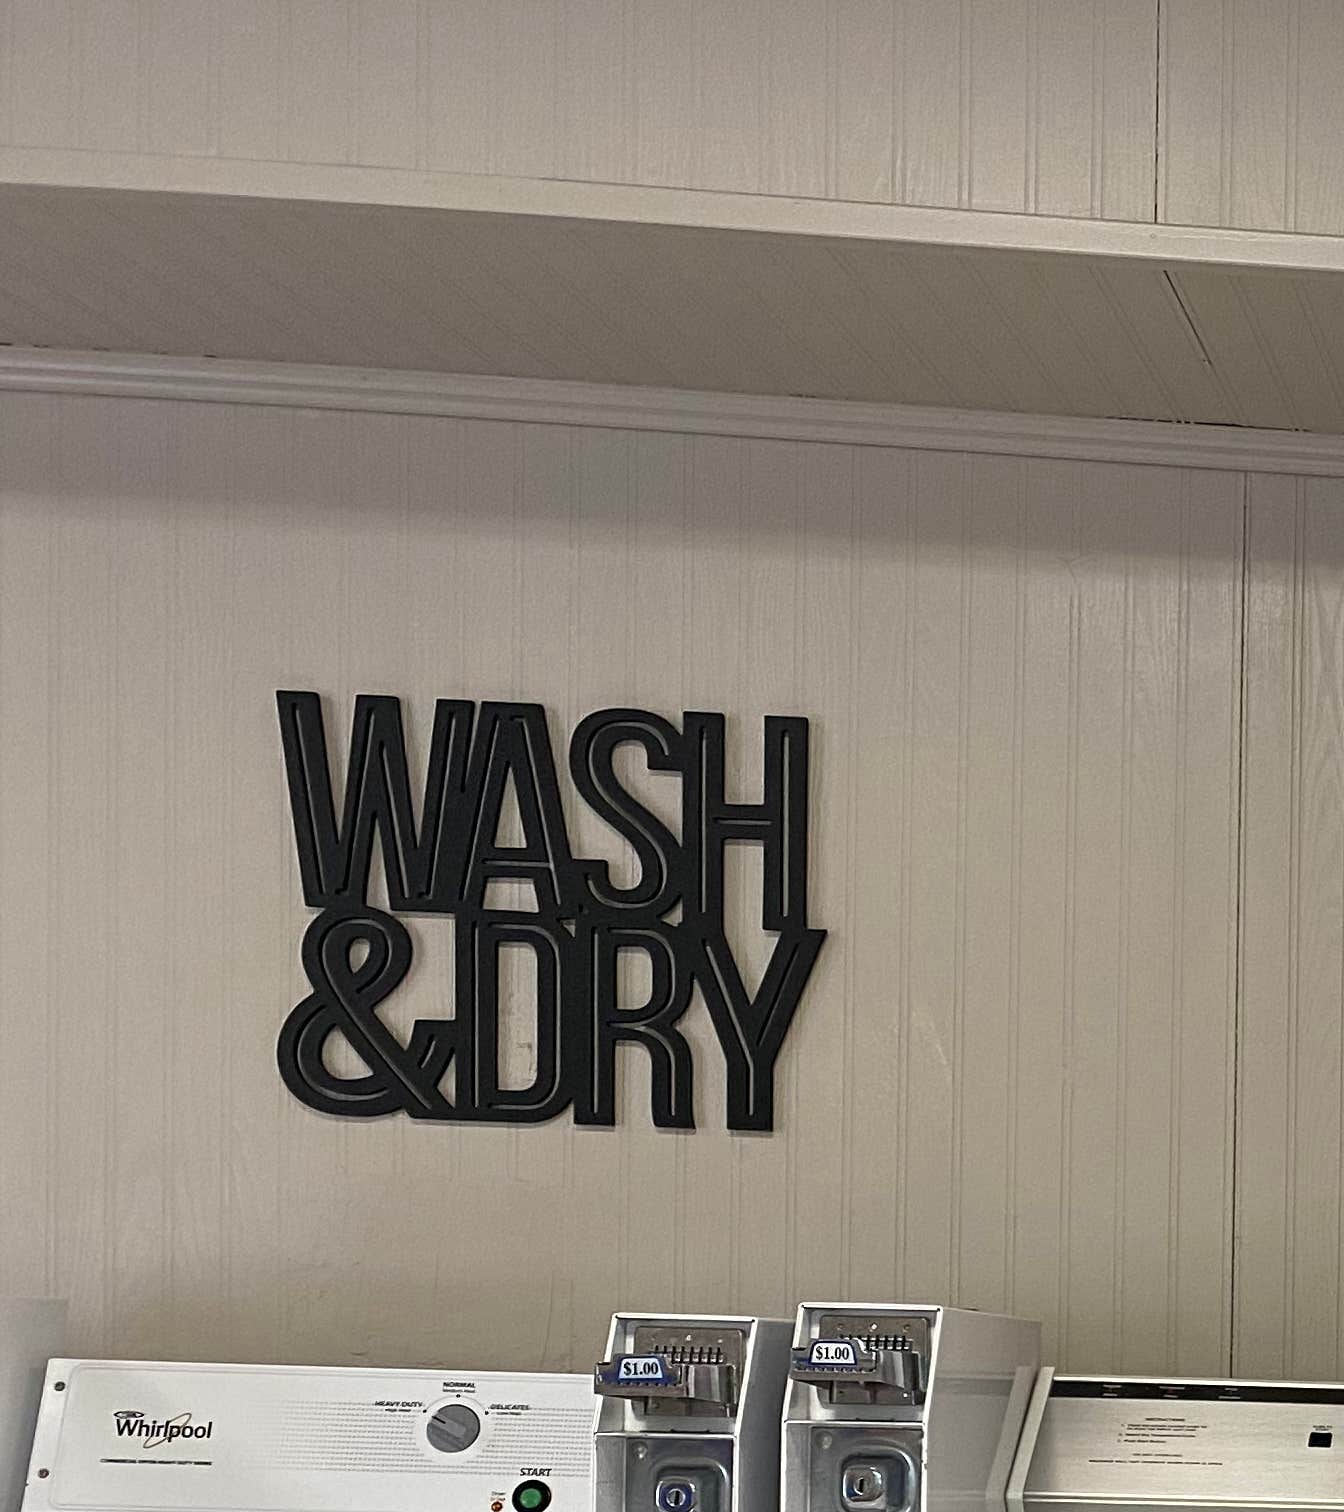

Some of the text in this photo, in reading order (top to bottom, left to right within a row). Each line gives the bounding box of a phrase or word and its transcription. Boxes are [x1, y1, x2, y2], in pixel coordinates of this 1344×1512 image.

[276, 690, 809, 931] WASH
[814, 1345, 851, 1362] $1.00
[622, 1360, 659, 1378] $1.00
[116, 1418, 213, 1443] Whirlpool
[520, 1467, 552, 1477] START
